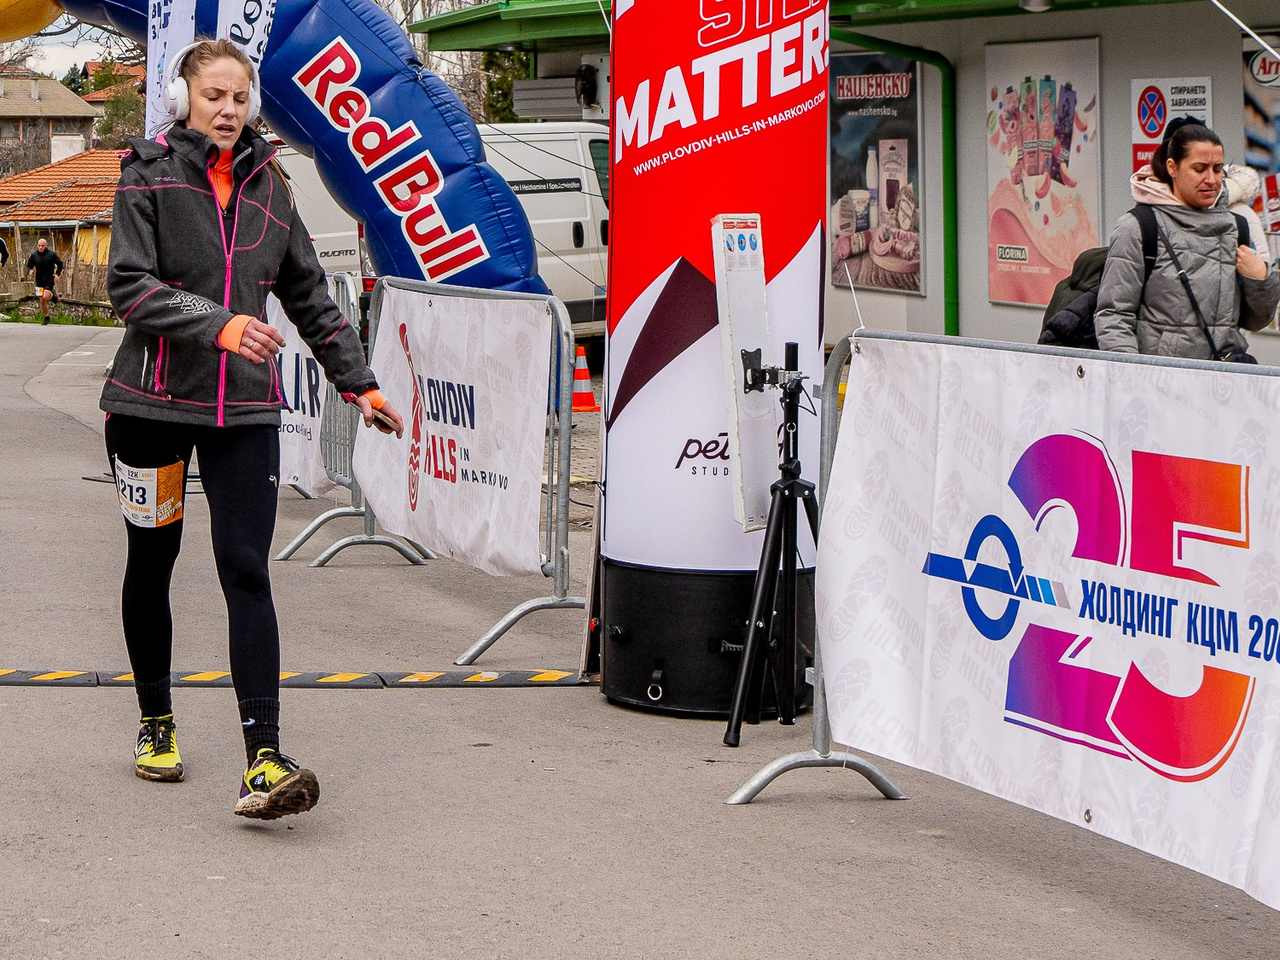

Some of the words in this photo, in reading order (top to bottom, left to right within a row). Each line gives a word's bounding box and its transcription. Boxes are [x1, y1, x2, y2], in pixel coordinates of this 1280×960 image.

[836, 74, 910, 99] НАШЕНСКО
[1170, 85, 1206, 95] СПИРАНЕТО
[294, 38, 420, 171] Red
[1170, 97, 1207, 107] ЗАБРАНЕНО
[632, 89, 826, 176] WWW.PLOVDIV-HILLS-IN-MARKOVO.COM
[376, 152, 489, 281] Bull
[319, 249, 356, 257] DUCATO
[998, 246, 1027, 261] FLORINA
[460, 446, 470, 462] IN
[461, 467, 509, 490] MARKOVO
[1078, 579, 1179, 638] ХОЛДИНГ
[1186, 602, 1239, 657] КЦМ
[1248, 614, 1280, 664] 20
